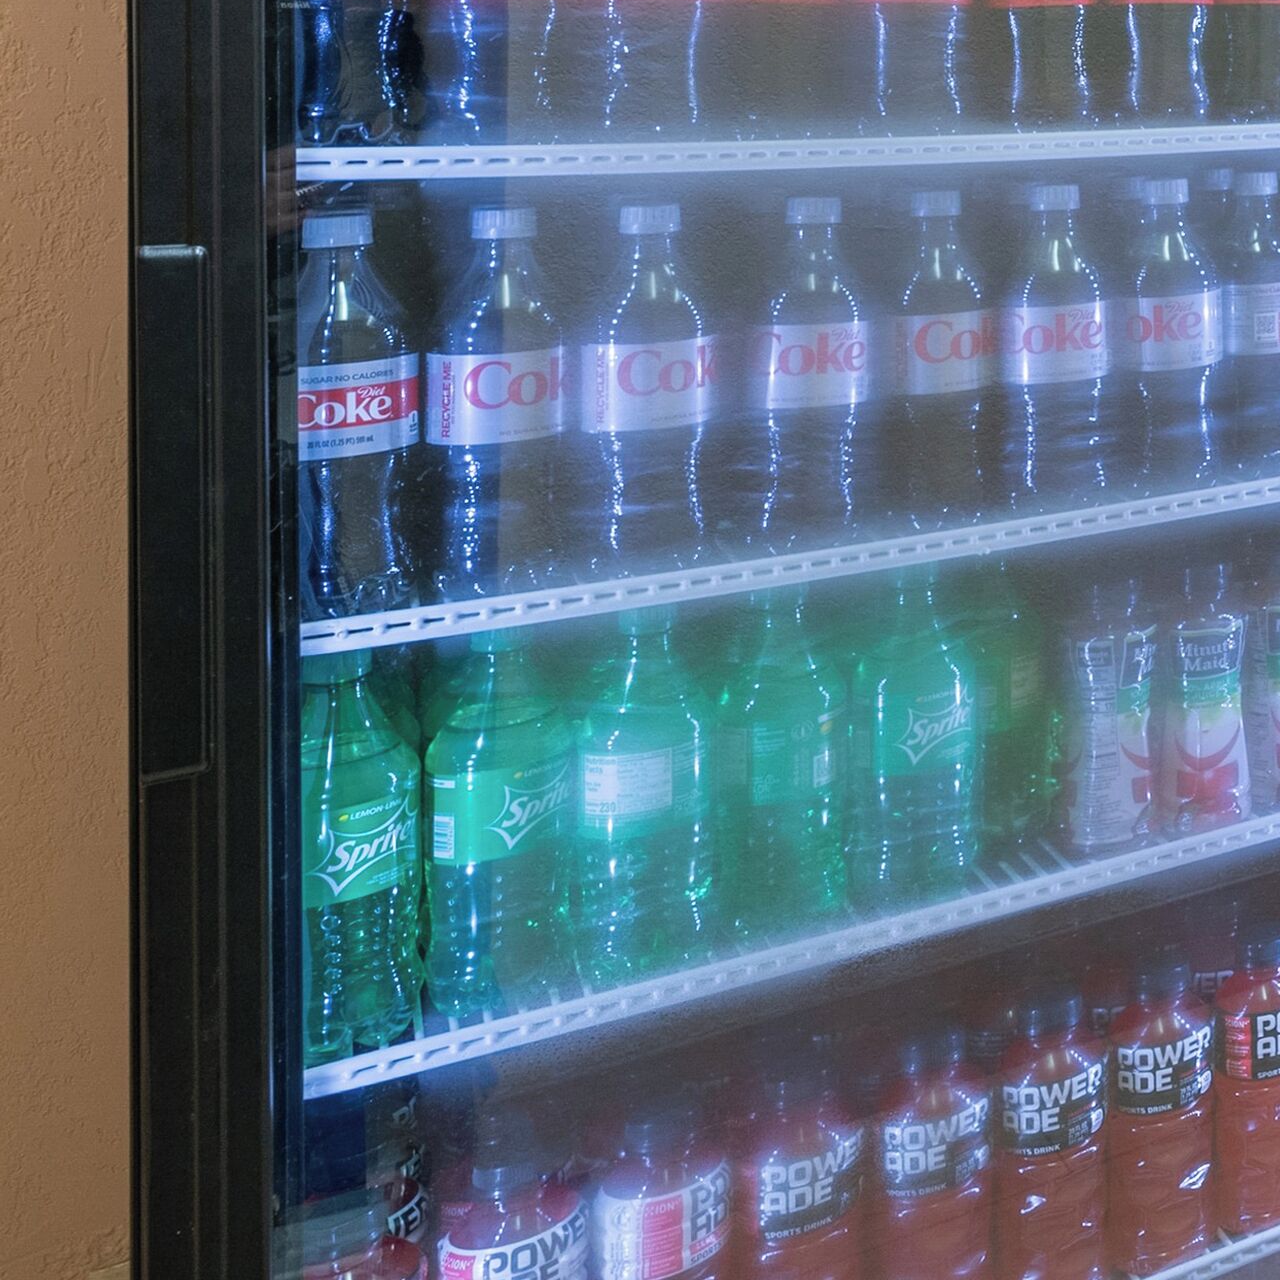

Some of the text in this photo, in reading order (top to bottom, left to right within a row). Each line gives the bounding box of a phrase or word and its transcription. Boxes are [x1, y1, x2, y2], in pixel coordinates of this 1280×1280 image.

[1164, 301, 1193, 313] Diet
[300, 370, 394, 386] SUGAR NO CALORIES
[357, 384, 386, 399] Diet
[298, 392, 393, 427] Coke
[441, 361, 451, 439] RECYCLE ME
[1184, 657, 1229, 671] Maid
[905, 705, 971, 746] Sprite
[599, 801, 617, 813] 230
[1118, 1025, 1211, 1071] POWER
[1002, 1063, 1103, 1112] POWER
[1118, 1067, 1173, 1094] ADE
[1002, 1107, 1061, 1135] ADE
[1147, 1103, 1173, 1114] DRINK
[884, 1097, 989, 1151] POWER
[885, 1145, 947, 1175] ADE
[1034, 1144, 1061, 1156] DRINK
[763, 1176, 834, 1215] ADE
[918, 1182, 947, 1196] DRINK
[765, 1217, 833, 1240] SPORTS DRINK
